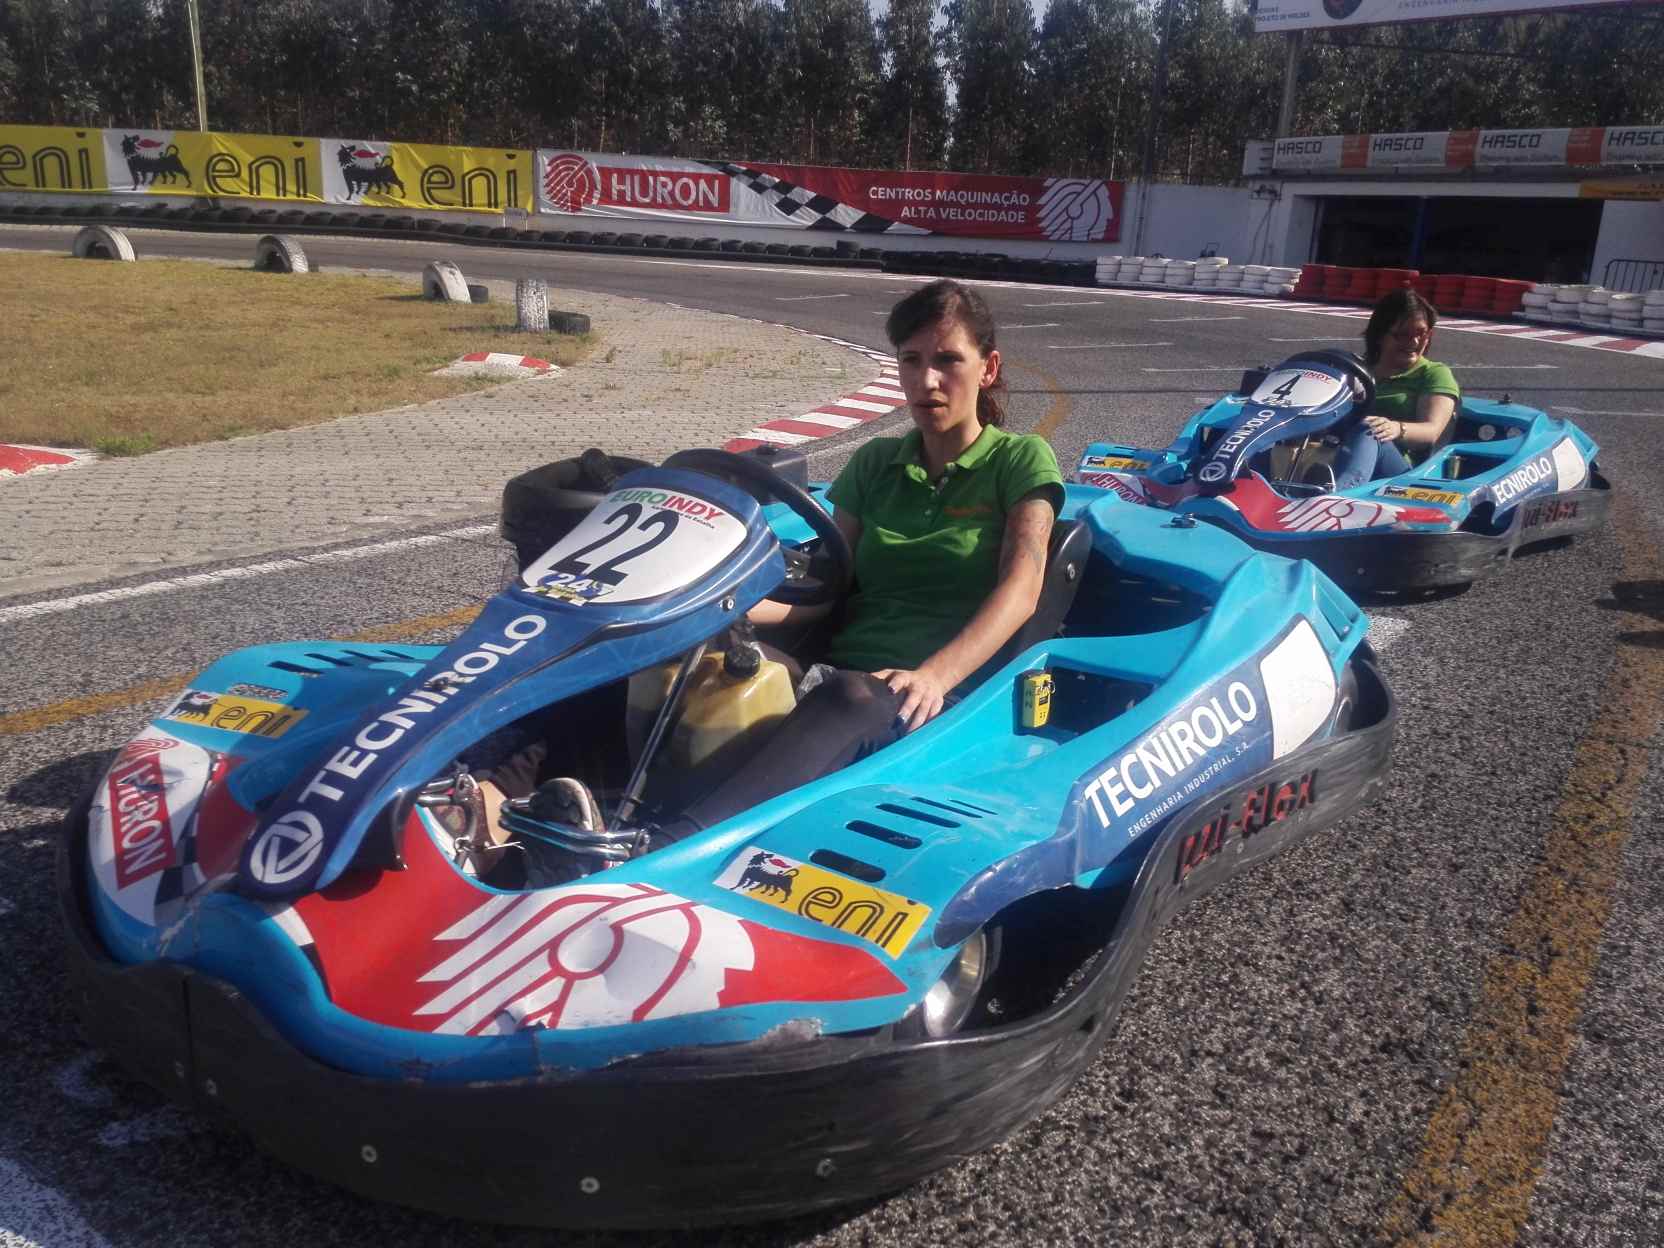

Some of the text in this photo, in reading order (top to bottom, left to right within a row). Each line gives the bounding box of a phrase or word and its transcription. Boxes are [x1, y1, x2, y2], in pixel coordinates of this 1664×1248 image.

[1276, 141, 1322, 156] HASCO
[1372, 137, 1424, 153] HASCO
[1480, 133, 1542, 149] HASCO
[1607, 130, 1664, 147] HASC
[0, 131, 93, 189] eni
[206, 141, 308, 198] eni
[420, 153, 519, 209] eni
[610, 172, 720, 208] HURON
[868, 186, 1030, 207] CENTROS MAQUINAÇÃO
[900, 205, 1026, 223] ALTA VELOCIDADE
[1272, 374, 1301, 401] 4
[609, 490, 725, 521] EUROINDY
[548, 502, 680, 586] 22
[211, 705, 299, 736] eni
[297, 615, 547, 802] TECNIROLO
[1083, 681, 1258, 828] TECNIROLO
[1127, 791, 1184, 838] ENGENHARIA
[798, 886, 920, 949] eni
